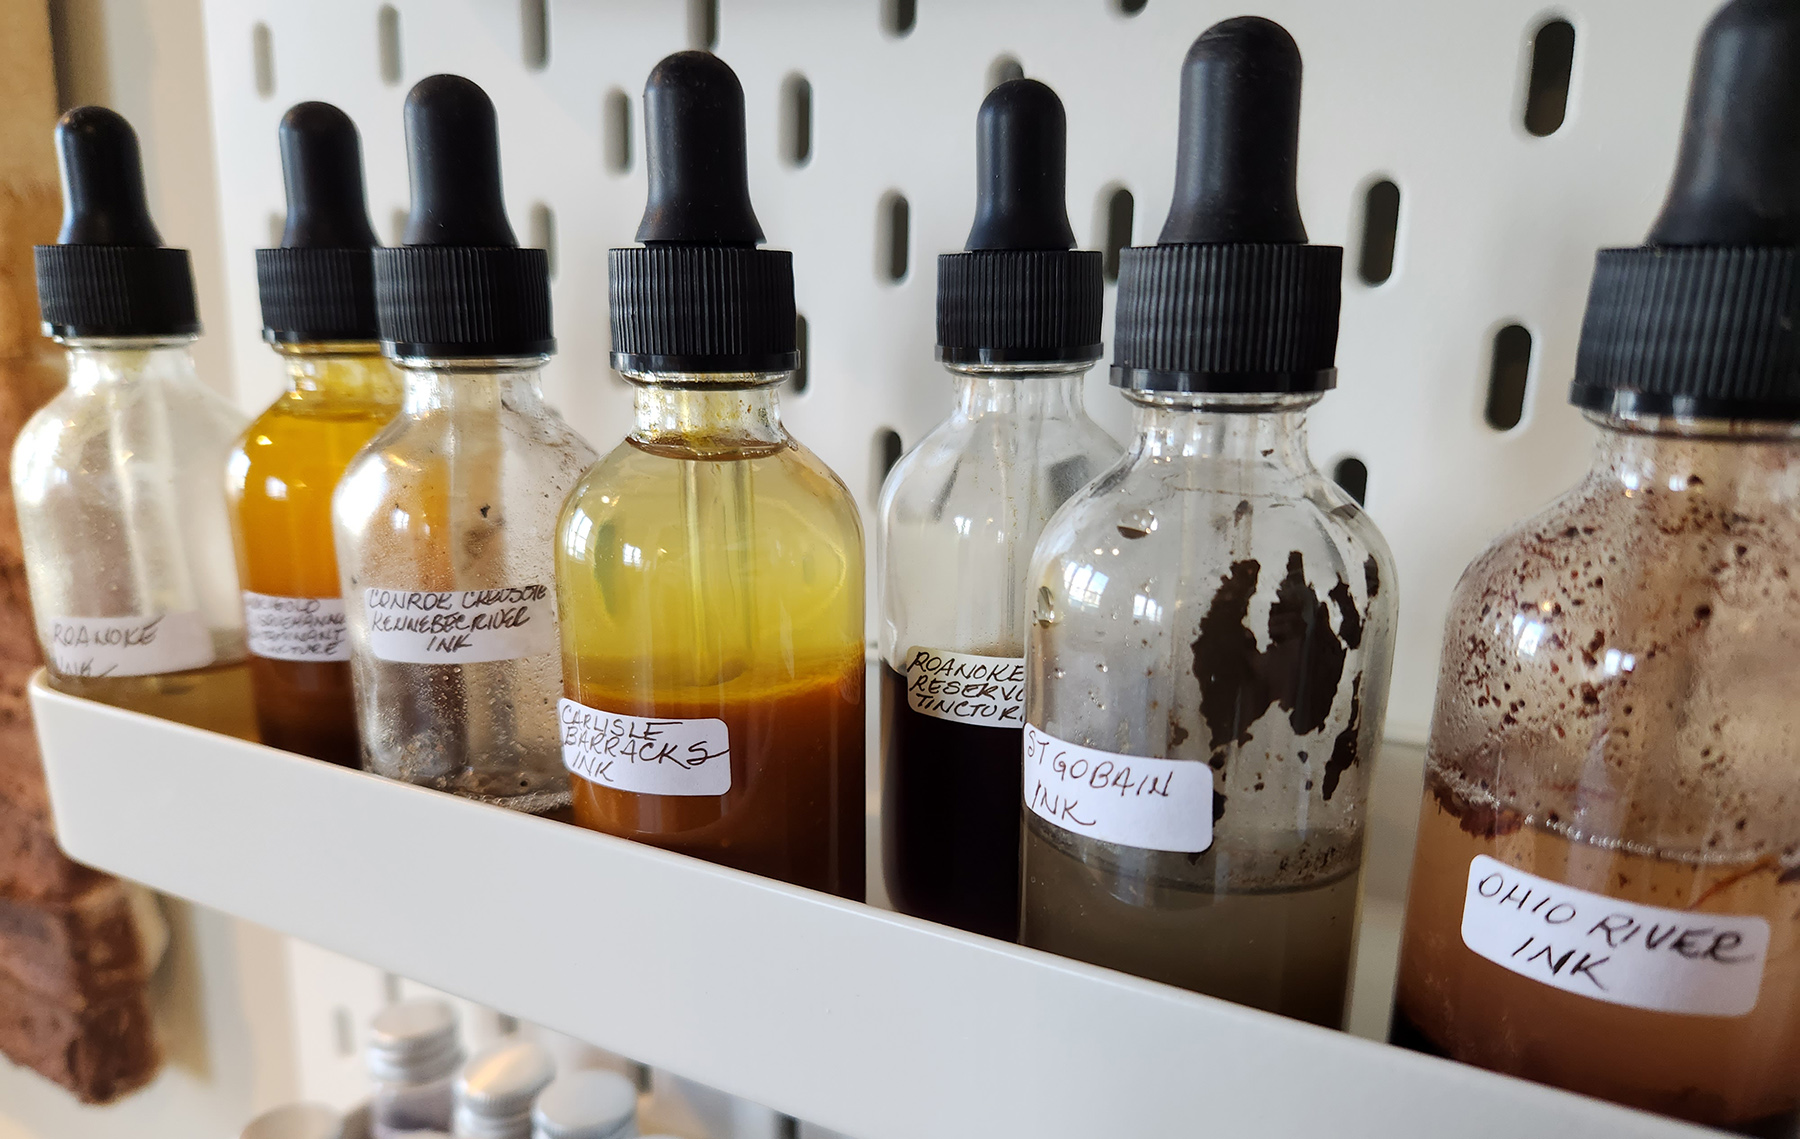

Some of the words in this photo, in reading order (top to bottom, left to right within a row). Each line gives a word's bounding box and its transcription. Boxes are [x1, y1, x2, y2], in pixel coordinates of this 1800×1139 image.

[53, 614, 167, 649] ROANOKE
[371, 611, 470, 634] KENNEBEC
[470, 605, 531, 633] RIVER
[426, 633, 473, 653] INK
[906, 651, 1024, 682] ROANOKE
[561, 703, 684, 742] CARLISLE
[915, 693, 1023, 722] TINCTUR
[563, 726, 731, 770] BARRACKS
[1027, 729, 1050, 765] ST
[1052, 750, 1174, 797] GOBAIN
[571, 751, 615, 783] INK
[1031, 779, 1097, 827] INK
[1477, 872, 1577, 925] OHIO
[1586, 912, 1756, 965] RIVER
[1510, 936, 1611, 992] INK
